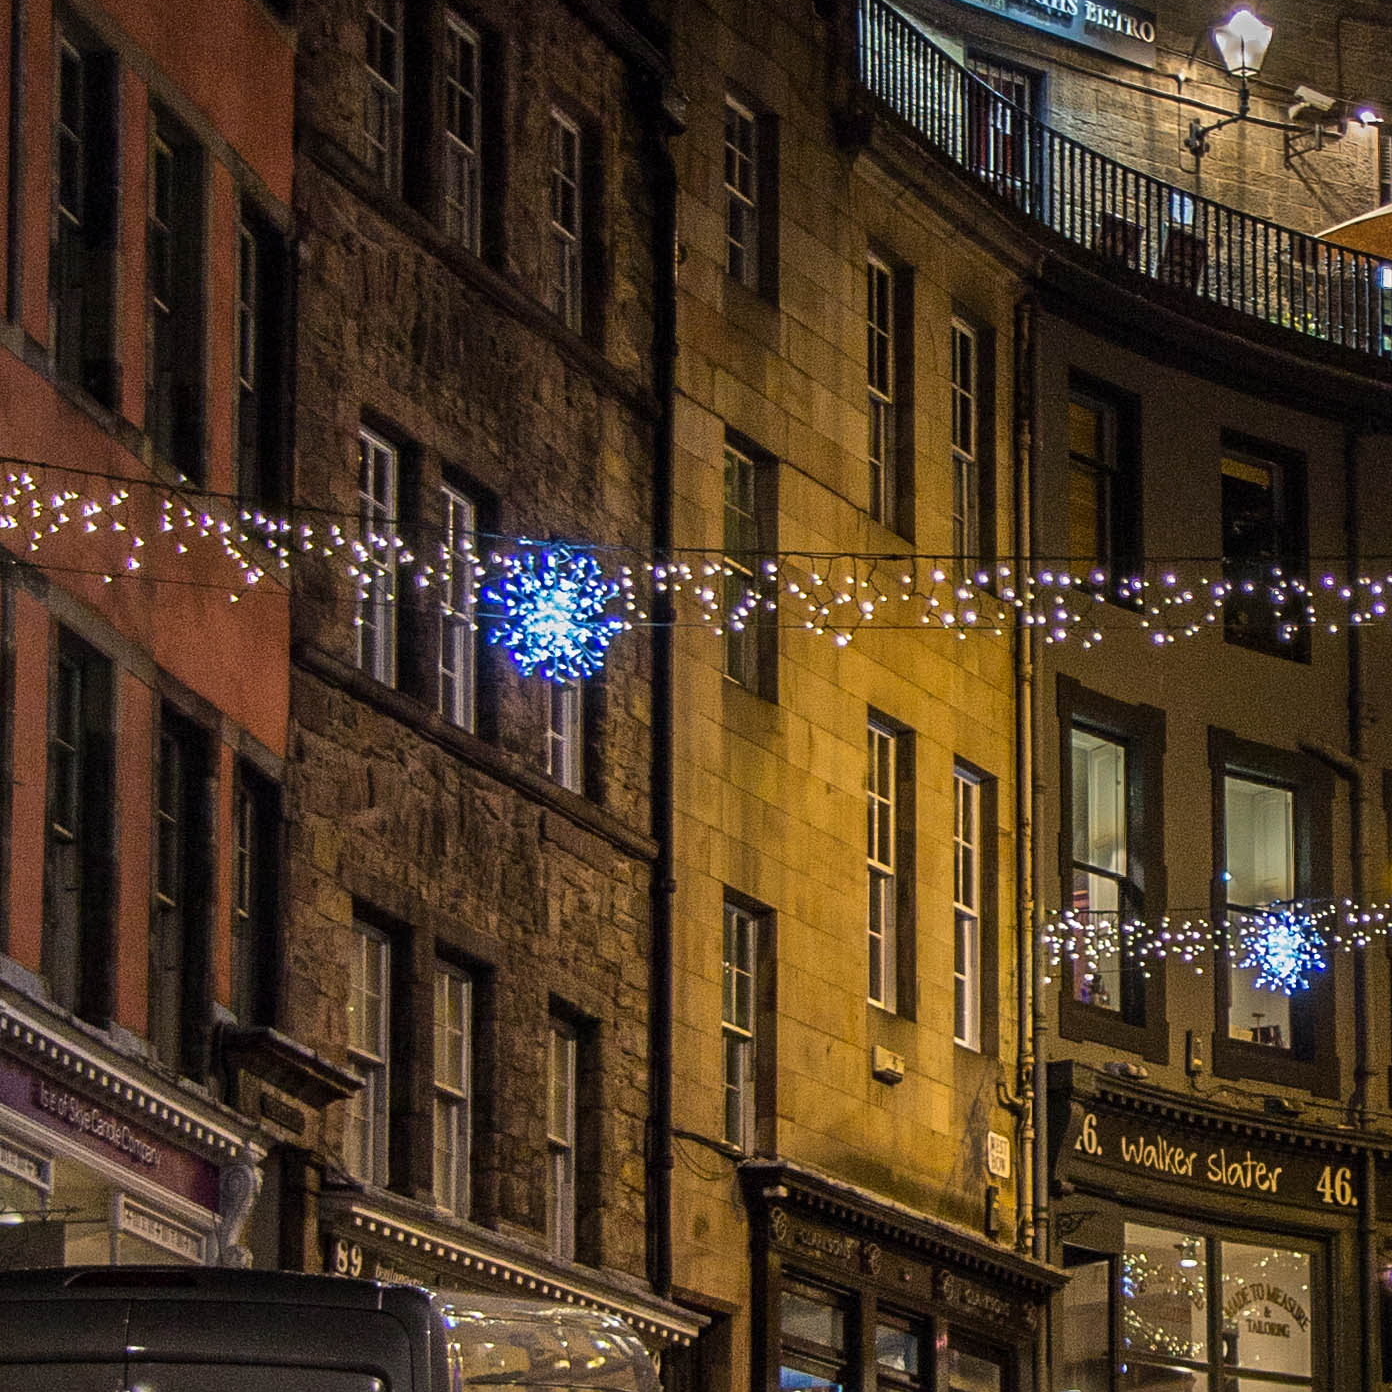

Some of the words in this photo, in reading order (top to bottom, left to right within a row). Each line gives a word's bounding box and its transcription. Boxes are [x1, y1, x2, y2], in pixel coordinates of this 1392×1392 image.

[1084, 0, 1156, 43] BISTRO
[1316, 1165, 1359, 1206] 46.
[336, 1239, 363, 1277] 89
[1222, 1286, 1251, 1318] MADE
[1249, 1282, 1265, 1300] TO
[1266, 1283, 1311, 1332] MEASURE
[1246, 1318, 1290, 1338] TAILORING
